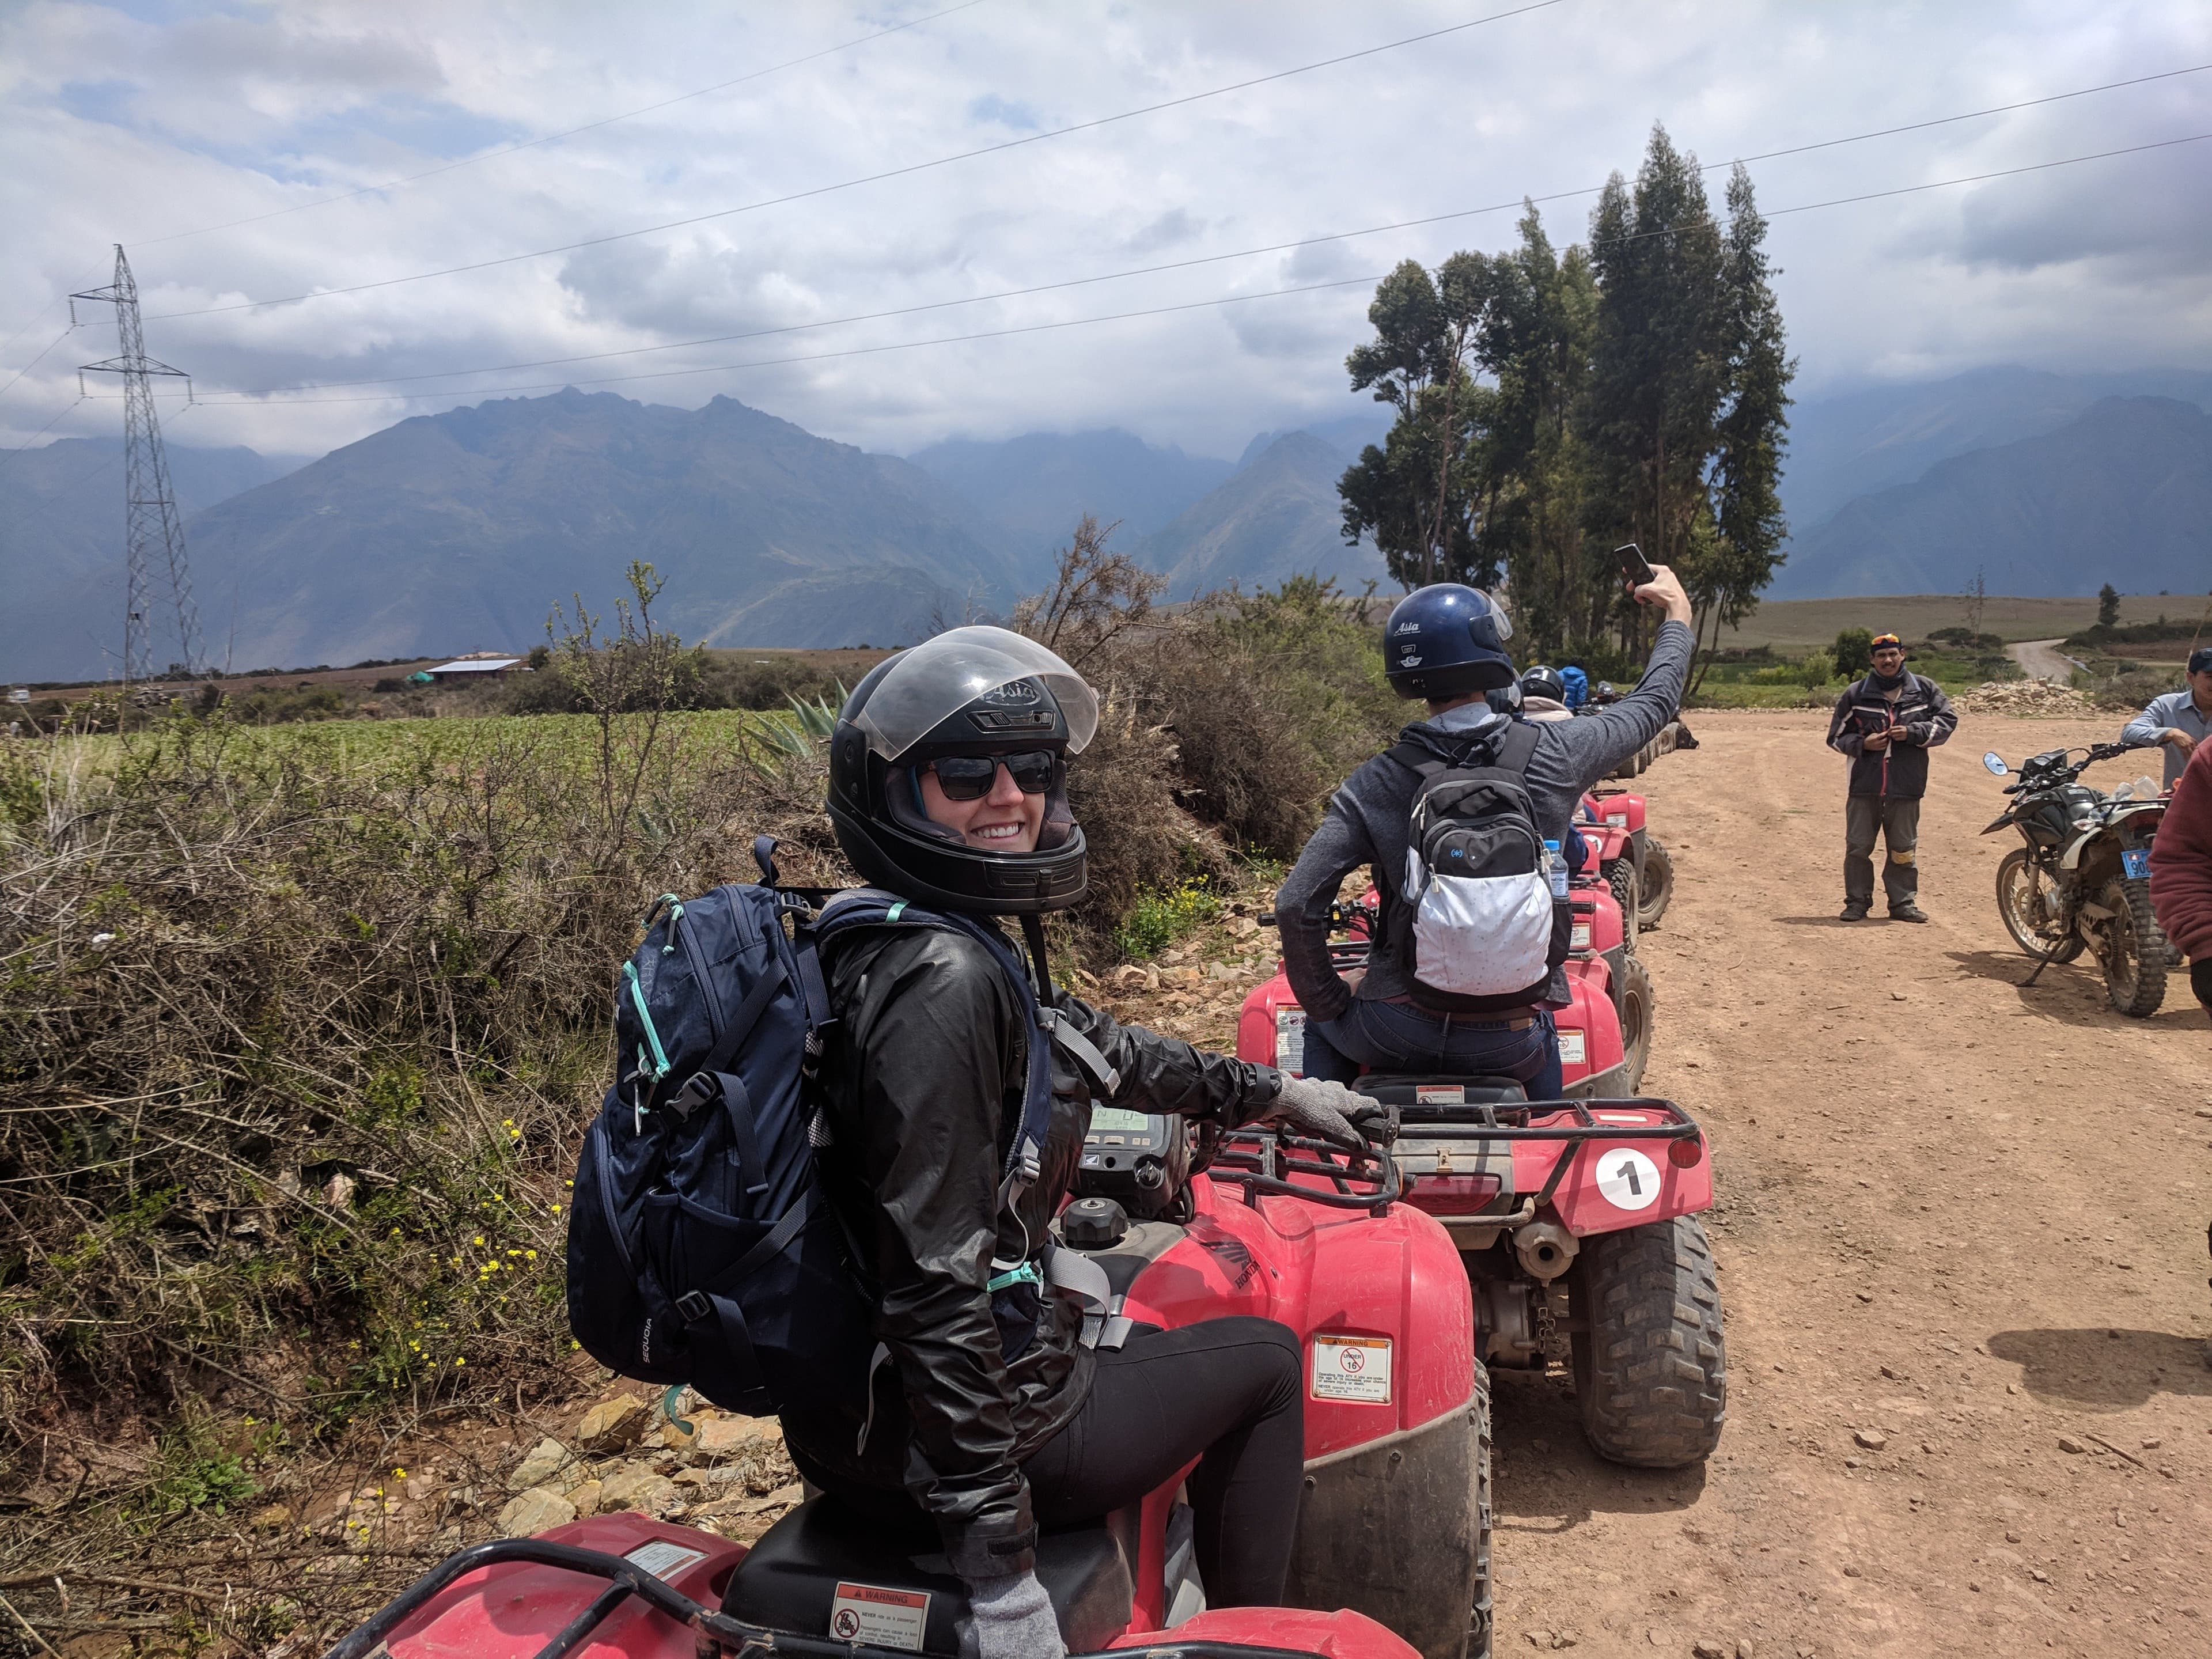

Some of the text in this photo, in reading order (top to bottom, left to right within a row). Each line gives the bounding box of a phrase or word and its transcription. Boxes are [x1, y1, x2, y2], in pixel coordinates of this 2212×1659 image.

[1395, 622, 1419, 633] Asia
[986, 683, 1035, 699] Asia
[2131, 861, 2149, 874] 90
[1616, 1161, 1642, 1195] 1
[1234, 1260, 1260, 1290] HONDA
[642, 1318, 652, 1363] SEQUOIA
[866, 1590, 908, 1604] WARNING
